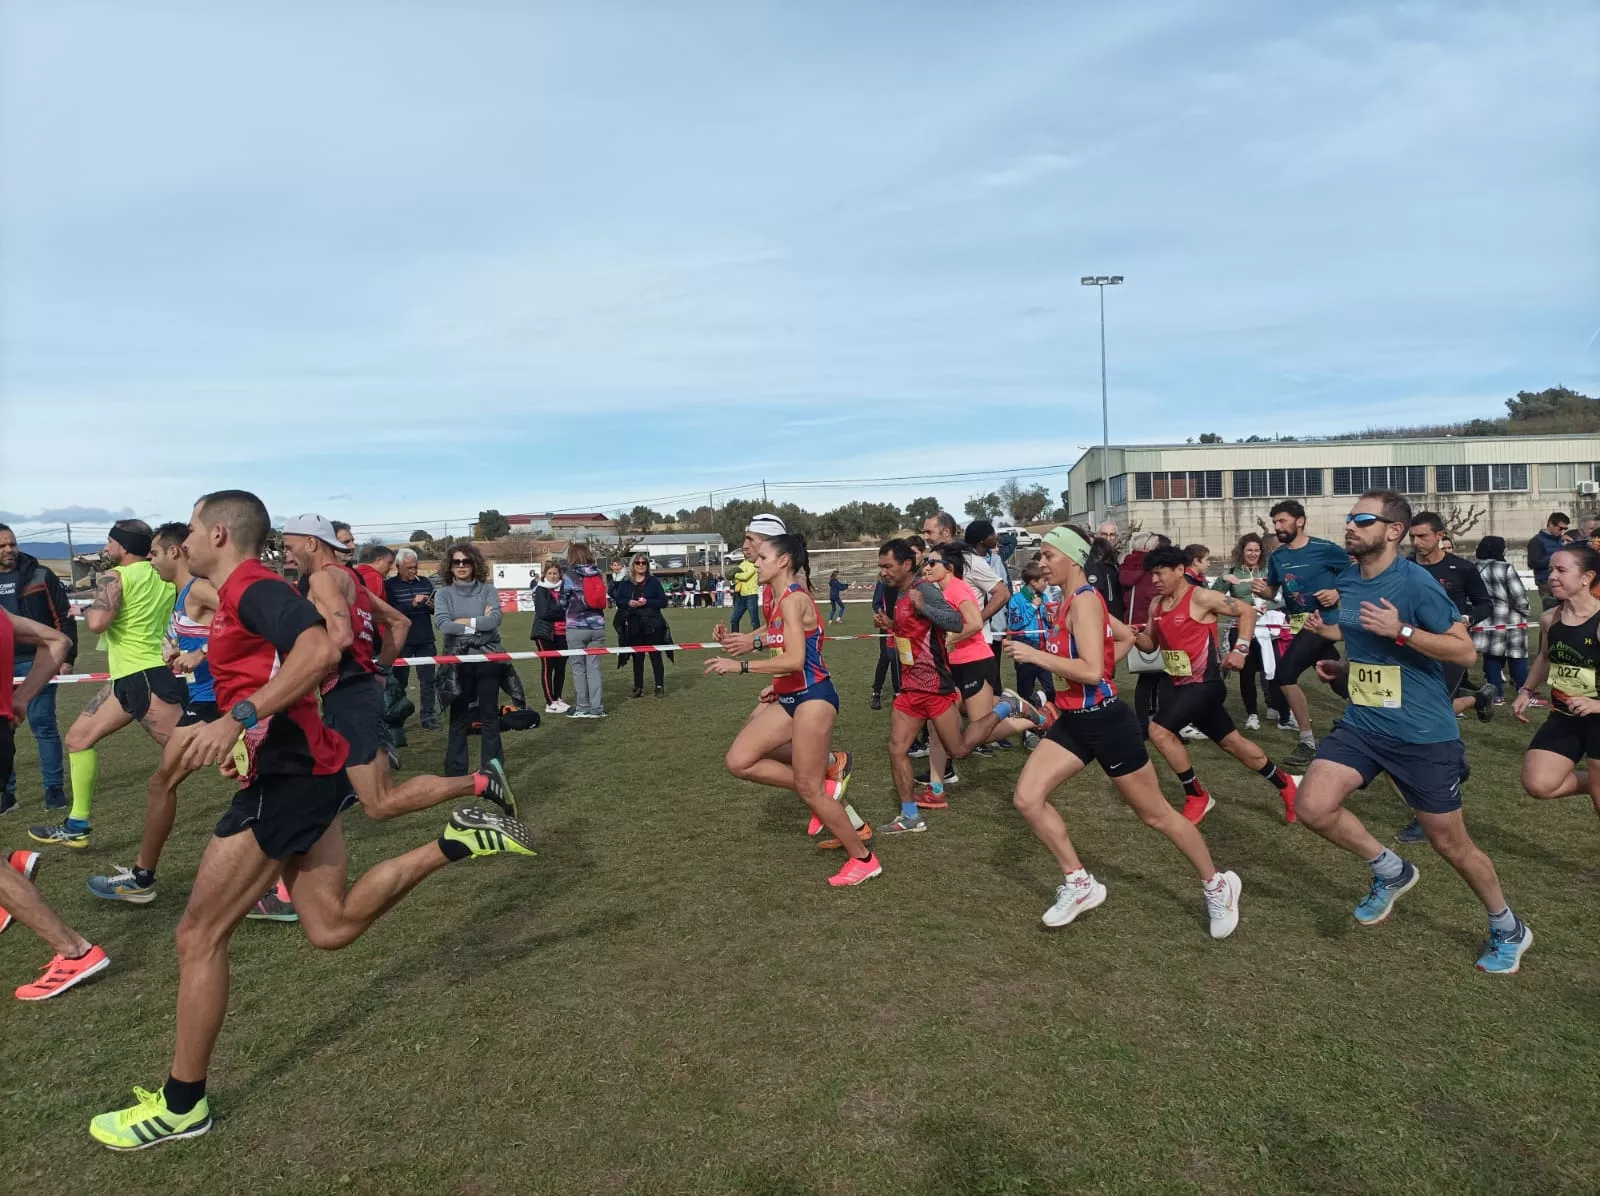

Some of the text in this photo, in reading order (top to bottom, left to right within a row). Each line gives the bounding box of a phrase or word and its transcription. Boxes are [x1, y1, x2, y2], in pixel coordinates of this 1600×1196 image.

[499, 571, 505, 579] 4
[1358, 668, 1382, 684] 011
[1557, 666, 1581, 679] 027
